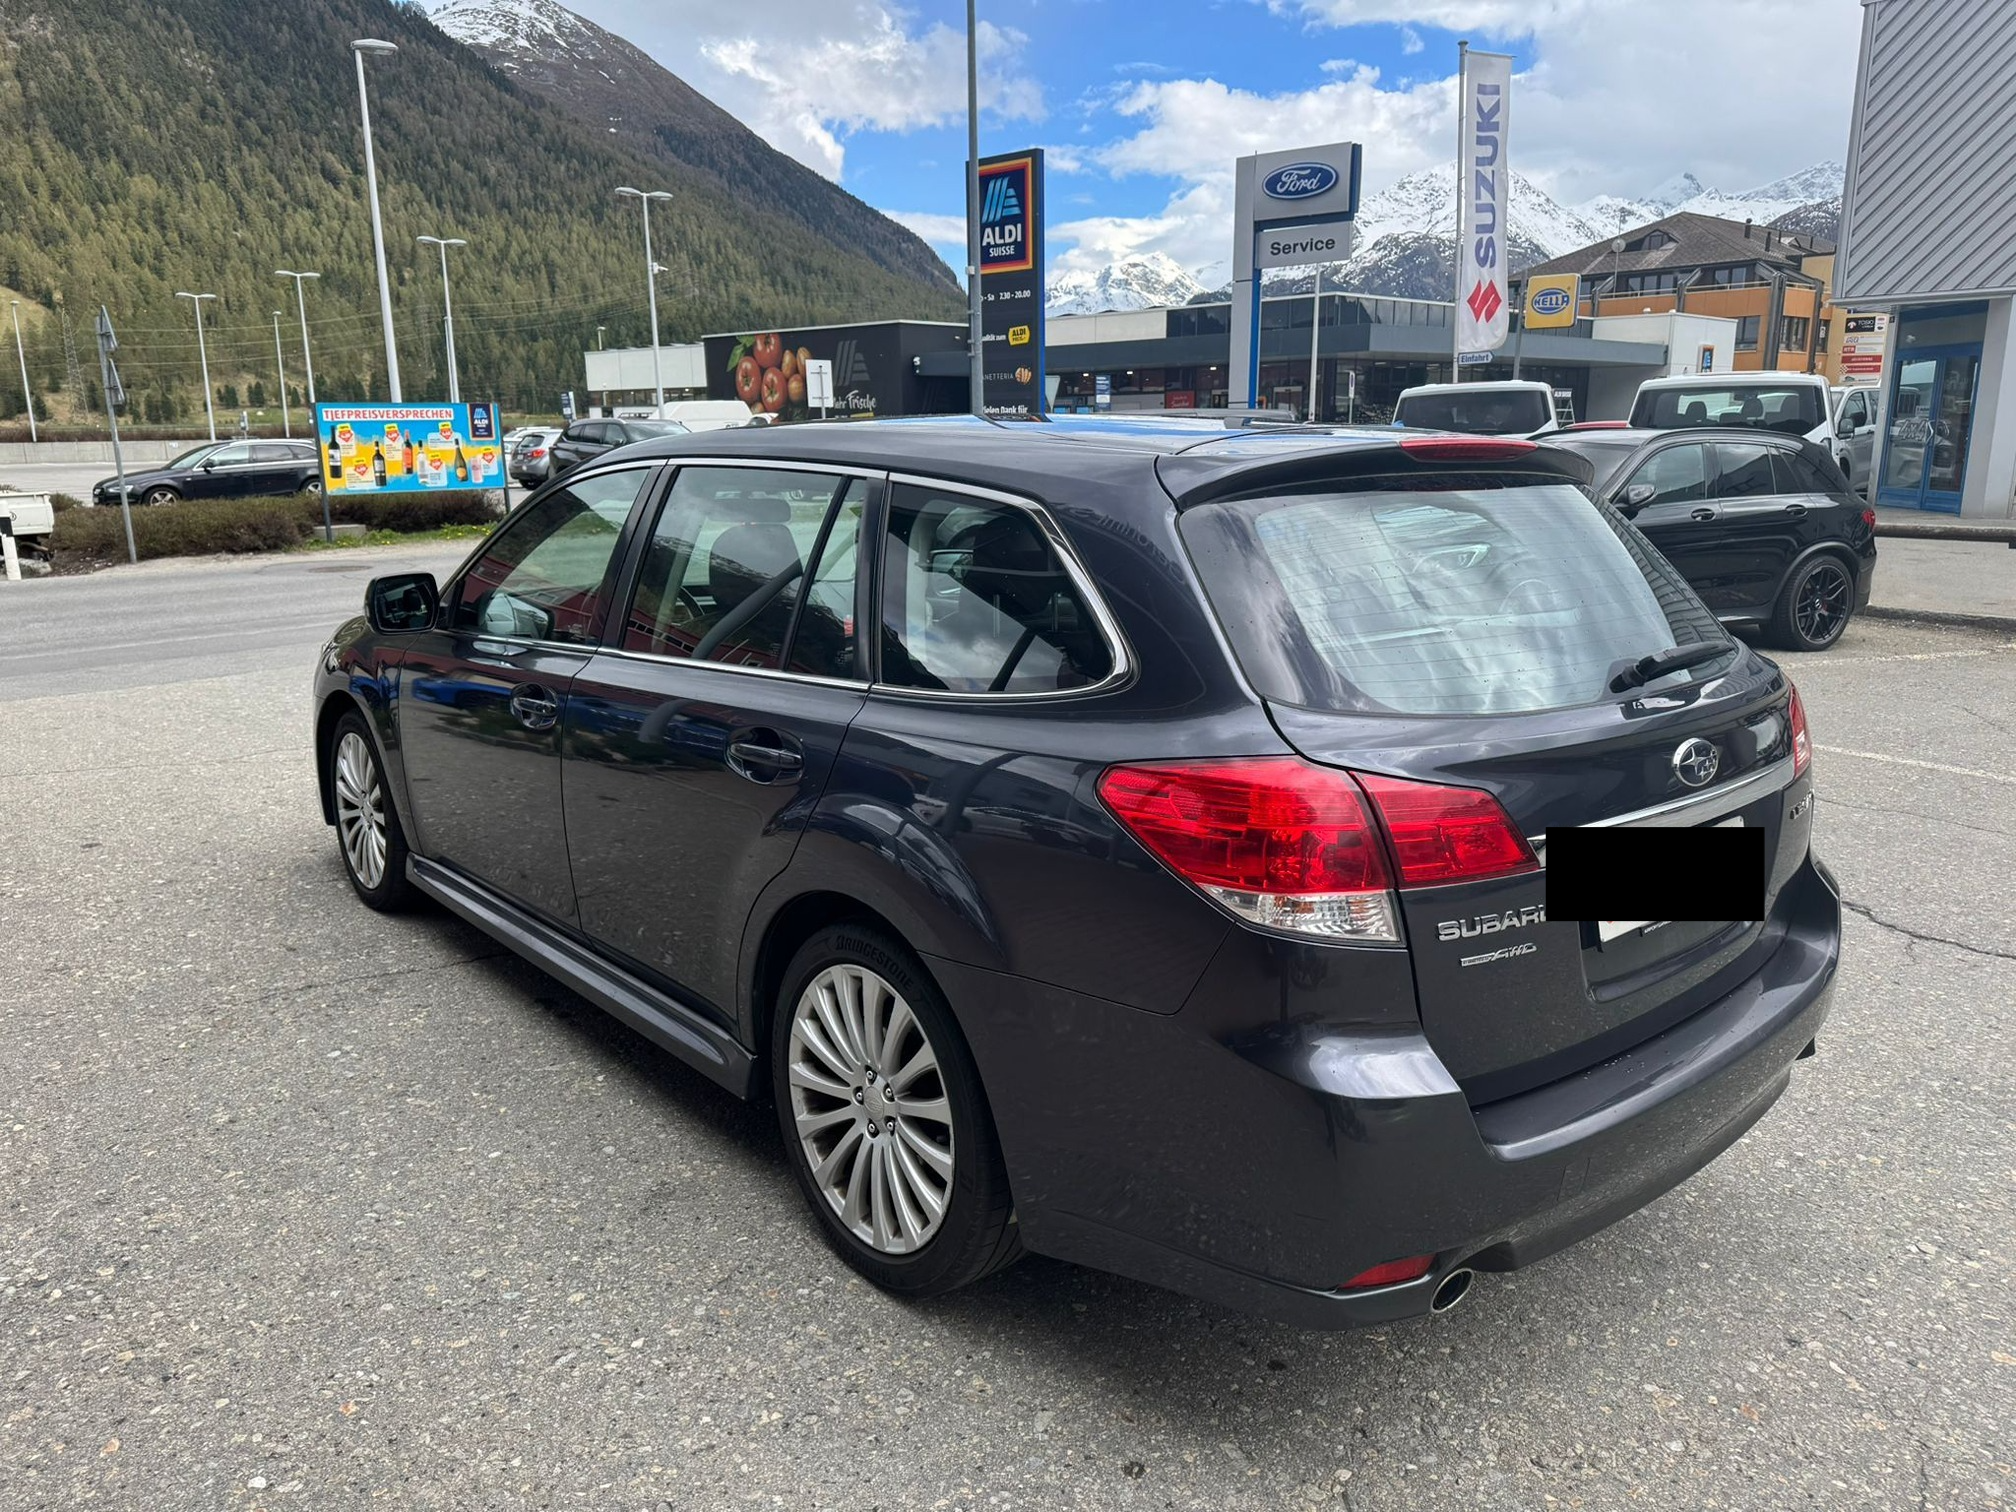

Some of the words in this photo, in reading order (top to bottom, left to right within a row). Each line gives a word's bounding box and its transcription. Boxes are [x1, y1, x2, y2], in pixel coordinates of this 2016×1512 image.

[1277, 169, 1321, 193] Ford
[1475, 84, 1500, 268] SUZUKI
[982, 223, 1021, 246] ALDI
[989, 245, 1015, 257] SUISSE
[1270, 238, 1335, 256] Service
[1014, 290, 1031, 299] 20.00
[1534, 294, 1570, 308] HELLA
[1012, 328, 1026, 337] ALDI
[1461, 353, 1489, 363] Einfahrt
[983, 372, 1014, 380] NETTERIA
[833, 396, 847, 409] ehr
[845, 390, 876, 411] Frische
[324, 409, 453, 421] TIEFPREISVERSPRECHEN
[1491, 943, 1537, 961] AWD
[836, 935, 914, 991] BRIDGESTONE
